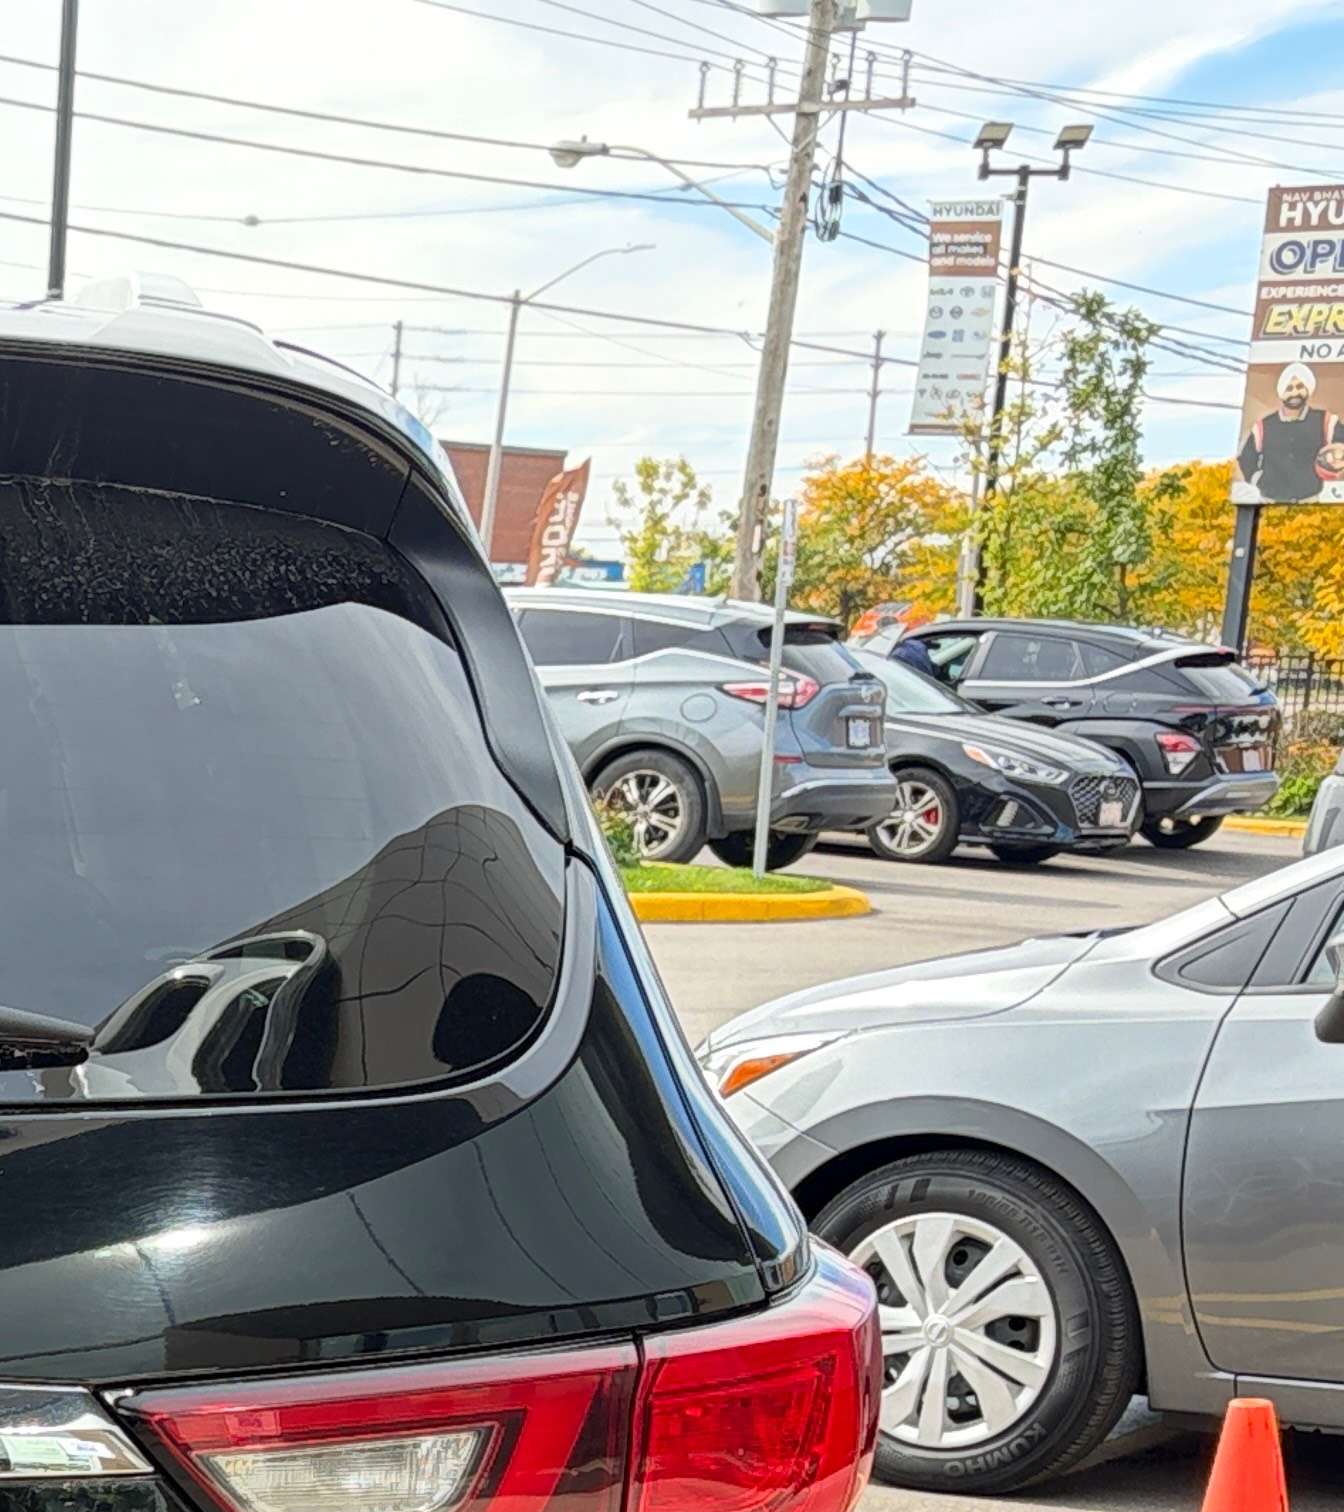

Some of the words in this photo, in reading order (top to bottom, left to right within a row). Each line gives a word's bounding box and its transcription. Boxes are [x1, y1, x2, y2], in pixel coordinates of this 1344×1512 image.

[1282, 191, 1310, 202] NAV
[933, 203, 1000, 217] HYUNDAI
[1300, 343, 1332, 359] NO
[943, 1422, 1047, 1476] KUMHO
